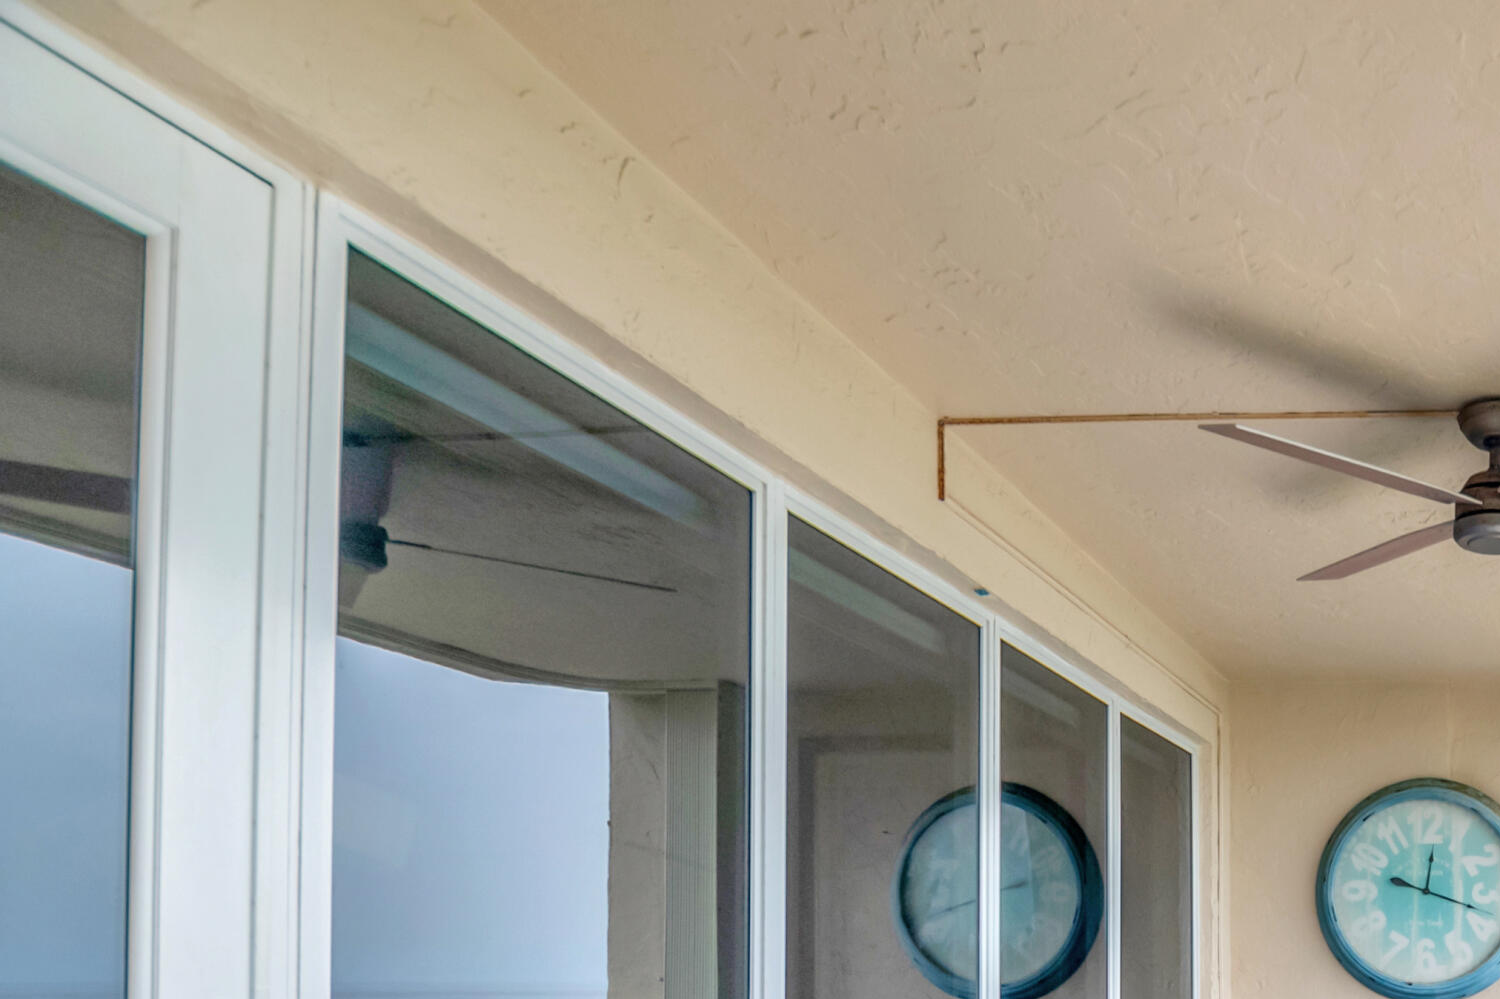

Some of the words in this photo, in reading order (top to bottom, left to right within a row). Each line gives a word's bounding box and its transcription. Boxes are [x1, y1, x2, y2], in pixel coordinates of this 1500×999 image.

[1377, 816, 1409, 855] 11
[1407, 807, 1443, 844] 12
[1351, 843, 1389, 876] 10
[1462, 844, 1499, 877] 2
[1342, 879, 1378, 902] 9
[1466, 911, 1498, 942] 4
[1382, 930, 1410, 967] 7
[1416, 938, 1437, 972] 6
